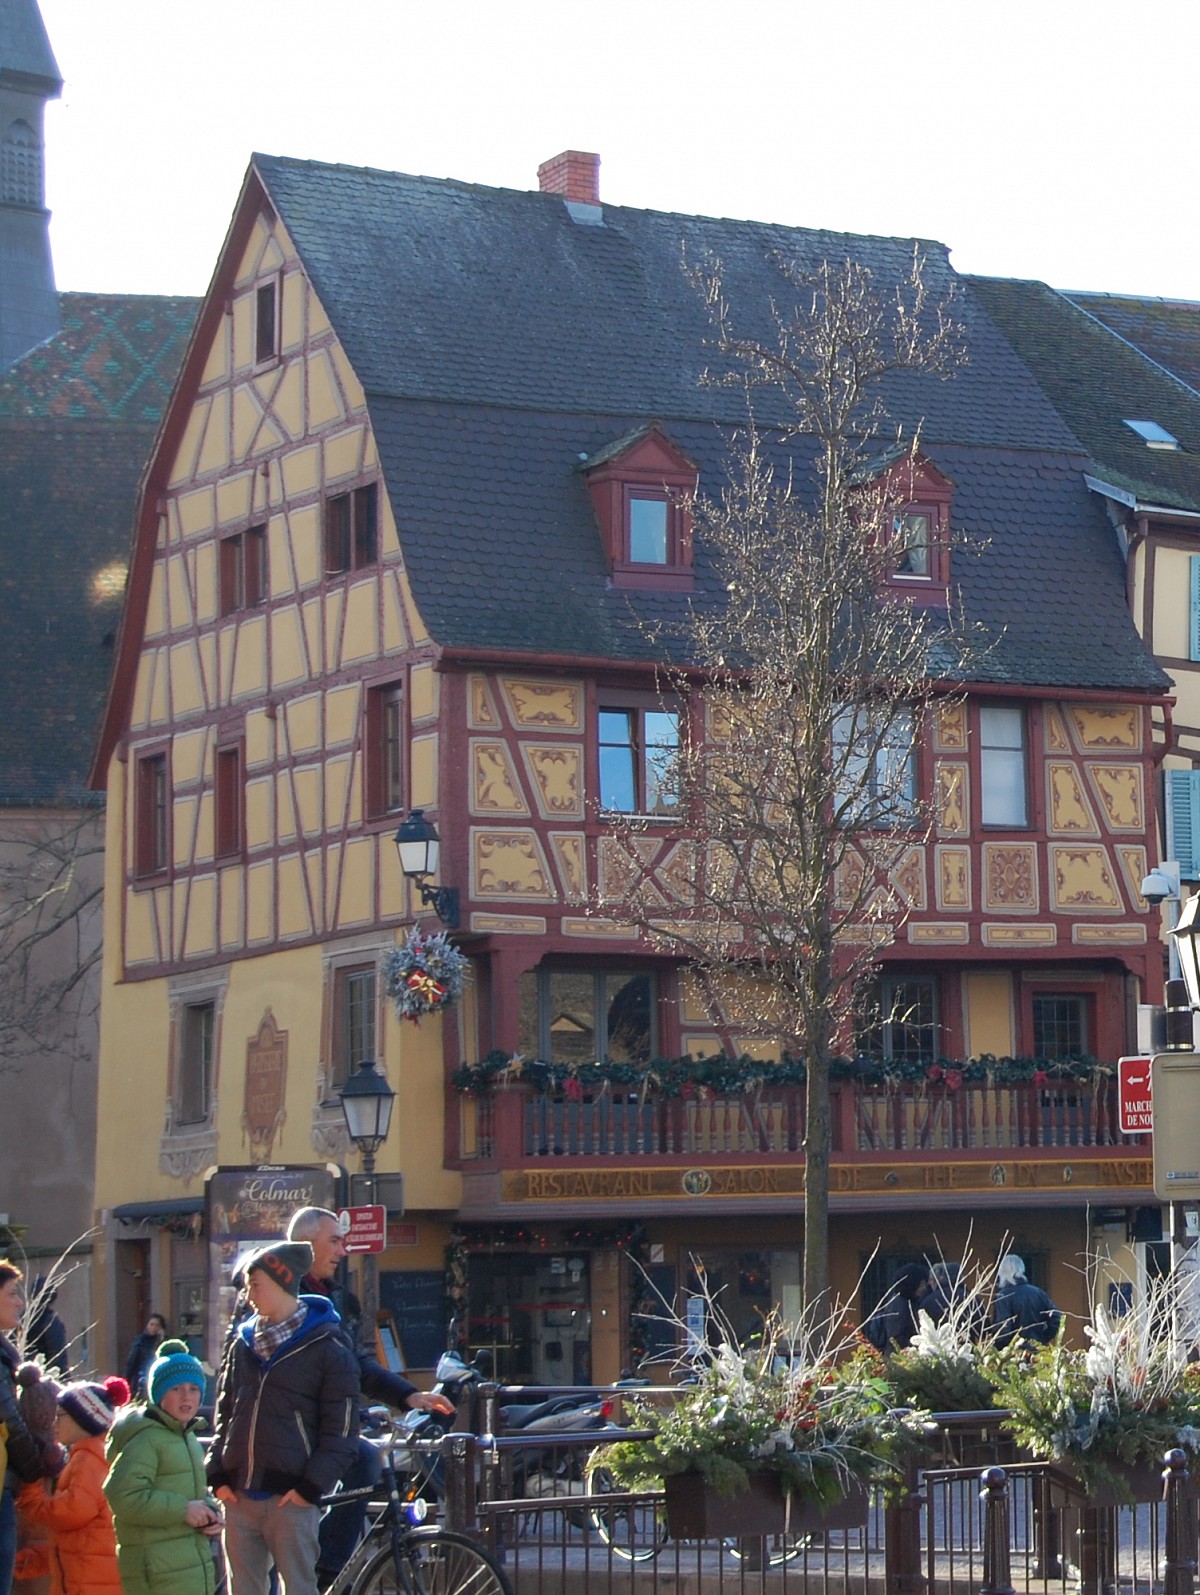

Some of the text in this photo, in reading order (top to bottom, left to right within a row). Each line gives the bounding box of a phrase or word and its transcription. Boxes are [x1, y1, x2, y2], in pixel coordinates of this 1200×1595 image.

[1124, 1100, 1153, 1113] MARCH
[1127, 1113, 1153, 1126] DE NOI
[714, 1169, 779, 1193] SALON
[836, 1167, 862, 1190] DE
[244, 1180, 314, 1201] Colmar
